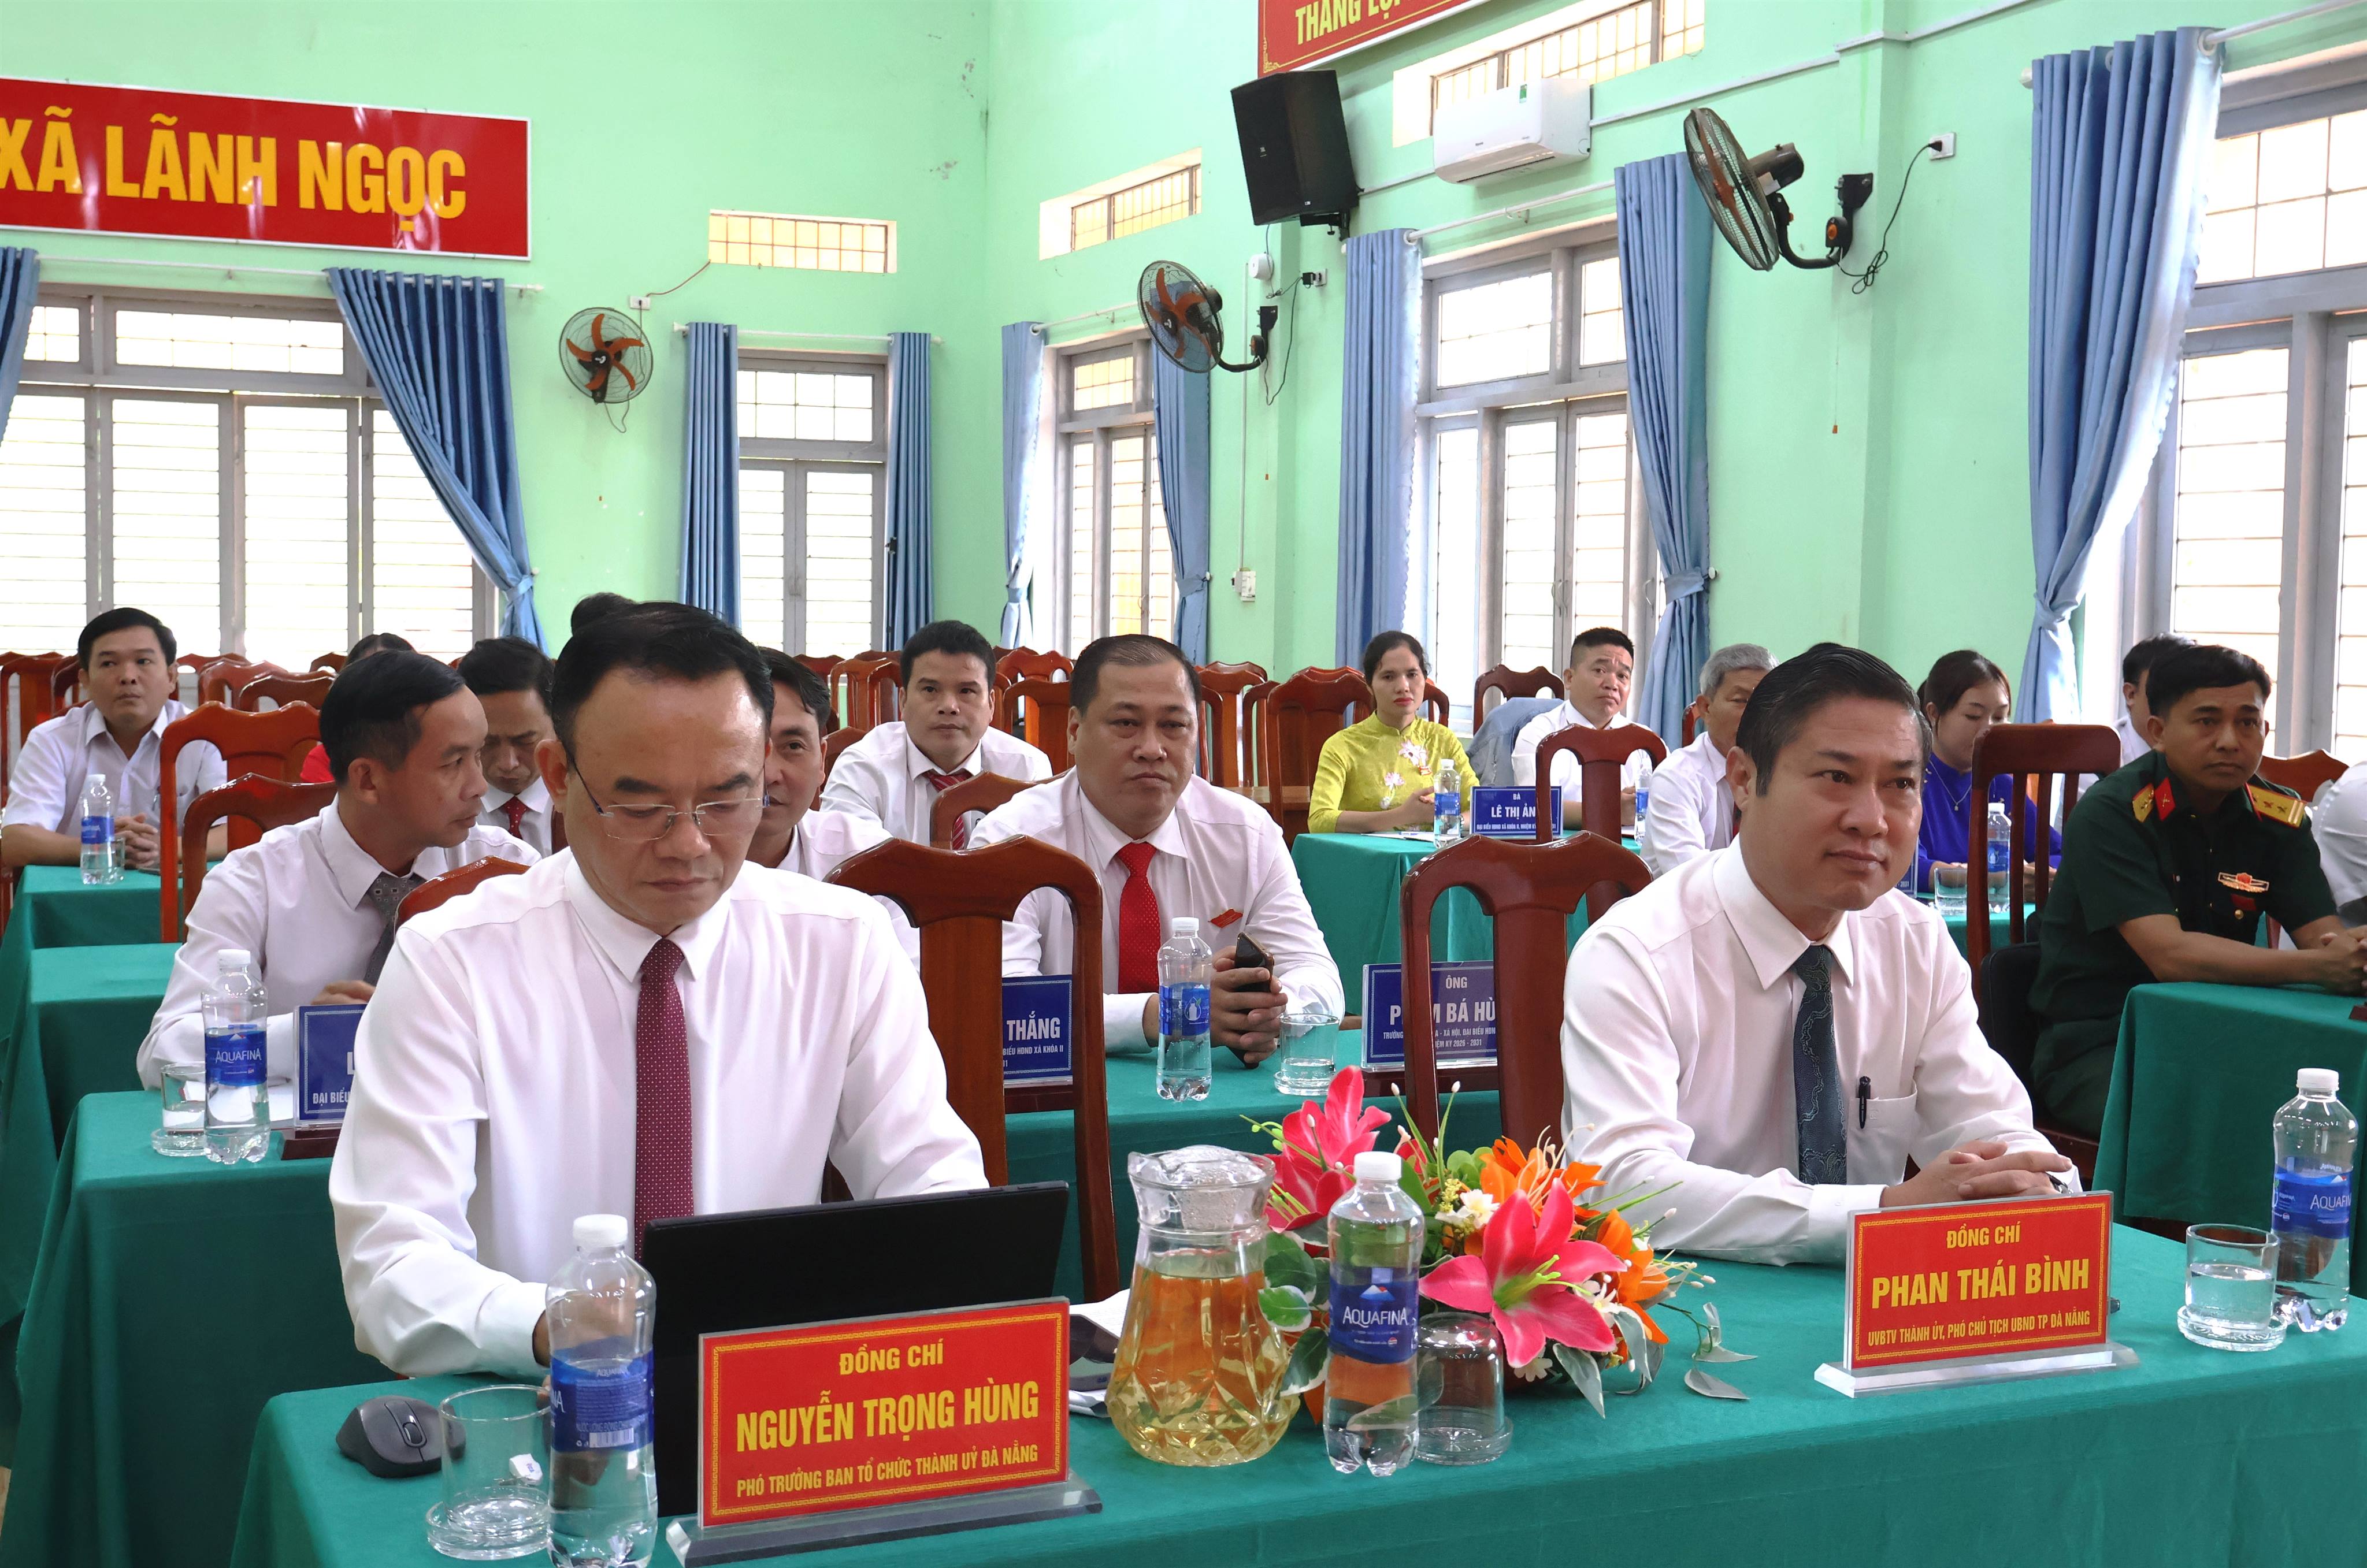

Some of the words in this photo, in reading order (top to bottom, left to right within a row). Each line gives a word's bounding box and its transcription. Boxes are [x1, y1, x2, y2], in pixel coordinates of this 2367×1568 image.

[0, 105, 82, 194] XÃ
[106, 113, 277, 207] LÃNH
[299, 140, 466, 232] NGỌC
[1492, 804, 1502, 818] LÊ
[1505, 807, 1519, 820] THỊ
[1445, 975, 1468, 989] ÔNG
[1446, 998, 1468, 1023] BÁ
[1474, 997, 1496, 1022] HÙ
[1007, 1010, 1060, 1041] THẮNG
[1472, 1025, 1484, 1035] BIỂU
[216, 1047, 262, 1064] AQUAFINA
[313, 1092, 328, 1106] ĐẠI
[330, 1087, 351, 1103] BIỂU
[2310, 1192, 2352, 1211] AQUAFIN
[1946, 1223, 1989, 1248] ĐỒNG
[1995, 1221, 2020, 1244] CHÍ
[1872, 1271, 1947, 1309] PHAN
[1957, 1259, 2016, 1301] THÁI
[2025, 1255, 2089, 1294] BÌNH
[1343, 1306, 1409, 1328] AQUAFINA
[1868, 1330, 1897, 1346] UVBTV
[1899, 1325, 1930, 1343] THÀNH
[1932, 1321, 1945, 1340] ỦY,
[1947, 1319, 1965, 1339] PHÓ
[1968, 1316, 1987, 1336] CHỦ
[1989, 1318, 2009, 1337] TỊCH
[2011, 1316, 2035, 1332] UBND
[2038, 1314, 2048, 1329] TP
[2051, 1310, 2062, 1328] ĐÀ
[2065, 1306, 2090, 1327] NẴNG
[839, 1343, 900, 1375] ĐỒNG
[907, 1338, 943, 1367] CHÍ
[736, 1390, 853, 1452] NGUYỄN
[863, 1390, 955, 1441] TRỌNG
[964, 1377, 1039, 1425] HÙNG
[737, 1474, 765, 1498] PHÓ
[769, 1467, 822, 1493] TRƯỞNG
[826, 1467, 853, 1487] BAN
[857, 1456, 874, 1482] TỔ
[877, 1456, 912, 1480] CHỨC
[915, 1452, 958, 1475] THÀNH
[961, 1445, 978, 1470] UỶ
[981, 1445, 999, 1468] ĐÀ
[1002, 1440, 1038, 1465] NẴNG
